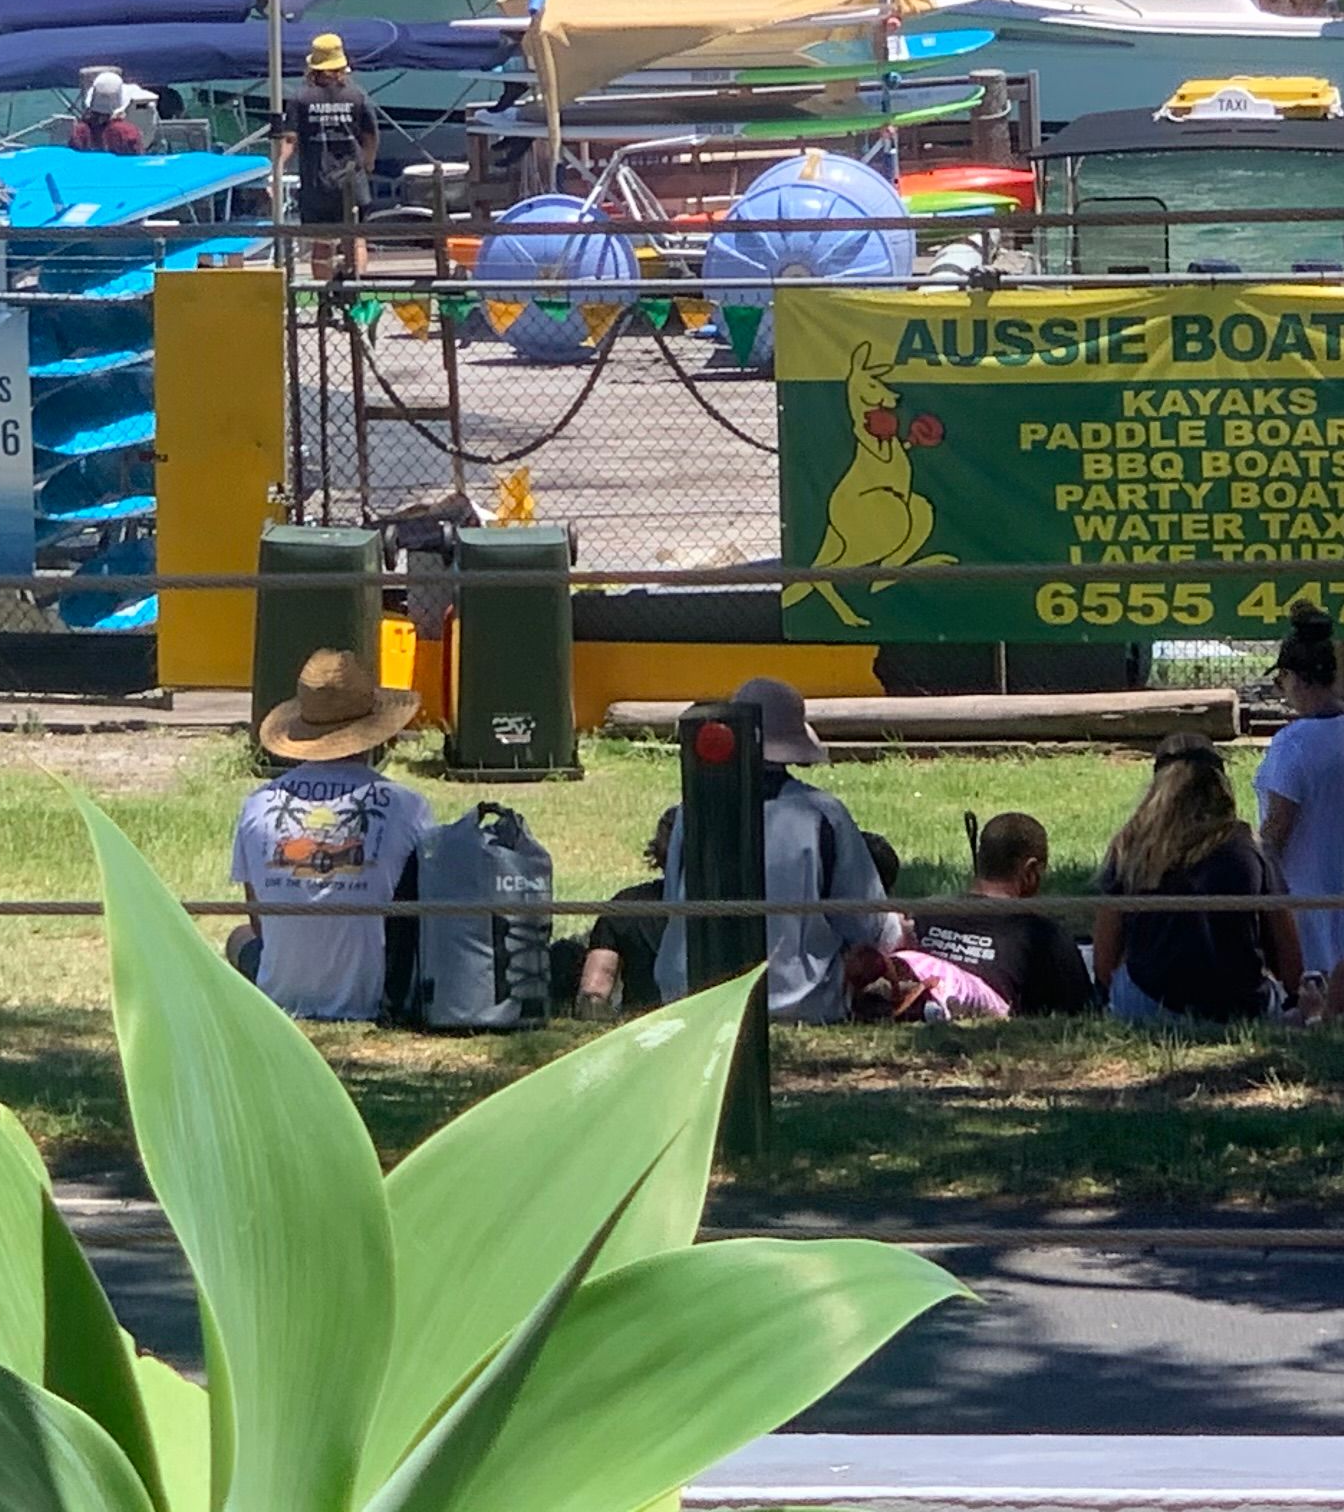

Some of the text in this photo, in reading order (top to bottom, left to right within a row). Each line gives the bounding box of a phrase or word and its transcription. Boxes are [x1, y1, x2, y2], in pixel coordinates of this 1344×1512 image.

[1218, 98, 1248, 112] TAXI
[895, 317, 1148, 366] AUSSIE
[1122, 388, 1318, 417] KAYAKS
[1020, 420, 1207, 450] PADDLE
[1083, 452, 1184, 480] BBQ
[1056, 483, 1213, 511] PARTY
[1073, 514, 1244, 541] WATER
[1035, 581, 1214, 625] 6555
[266, 779, 391, 808] SMOOTH AS
